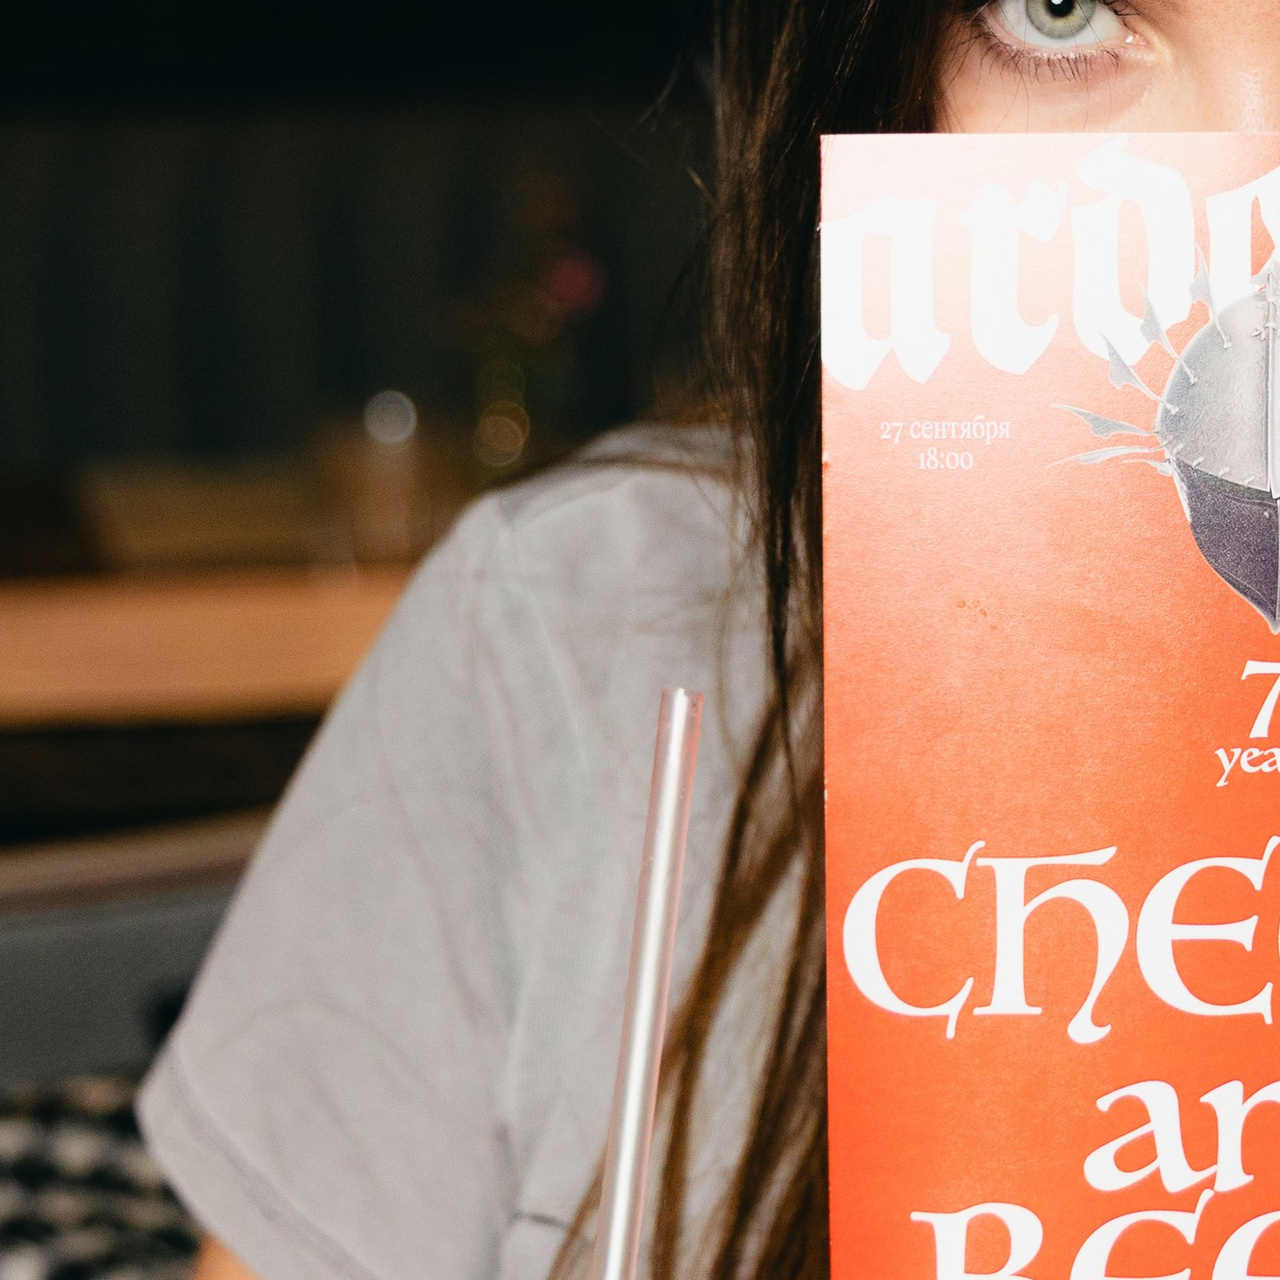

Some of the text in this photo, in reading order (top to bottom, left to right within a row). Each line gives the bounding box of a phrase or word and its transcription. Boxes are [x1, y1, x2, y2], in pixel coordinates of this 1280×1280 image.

[880, 414, 1012, 445] 27 сентября
[919, 447, 974, 470] 18:00
